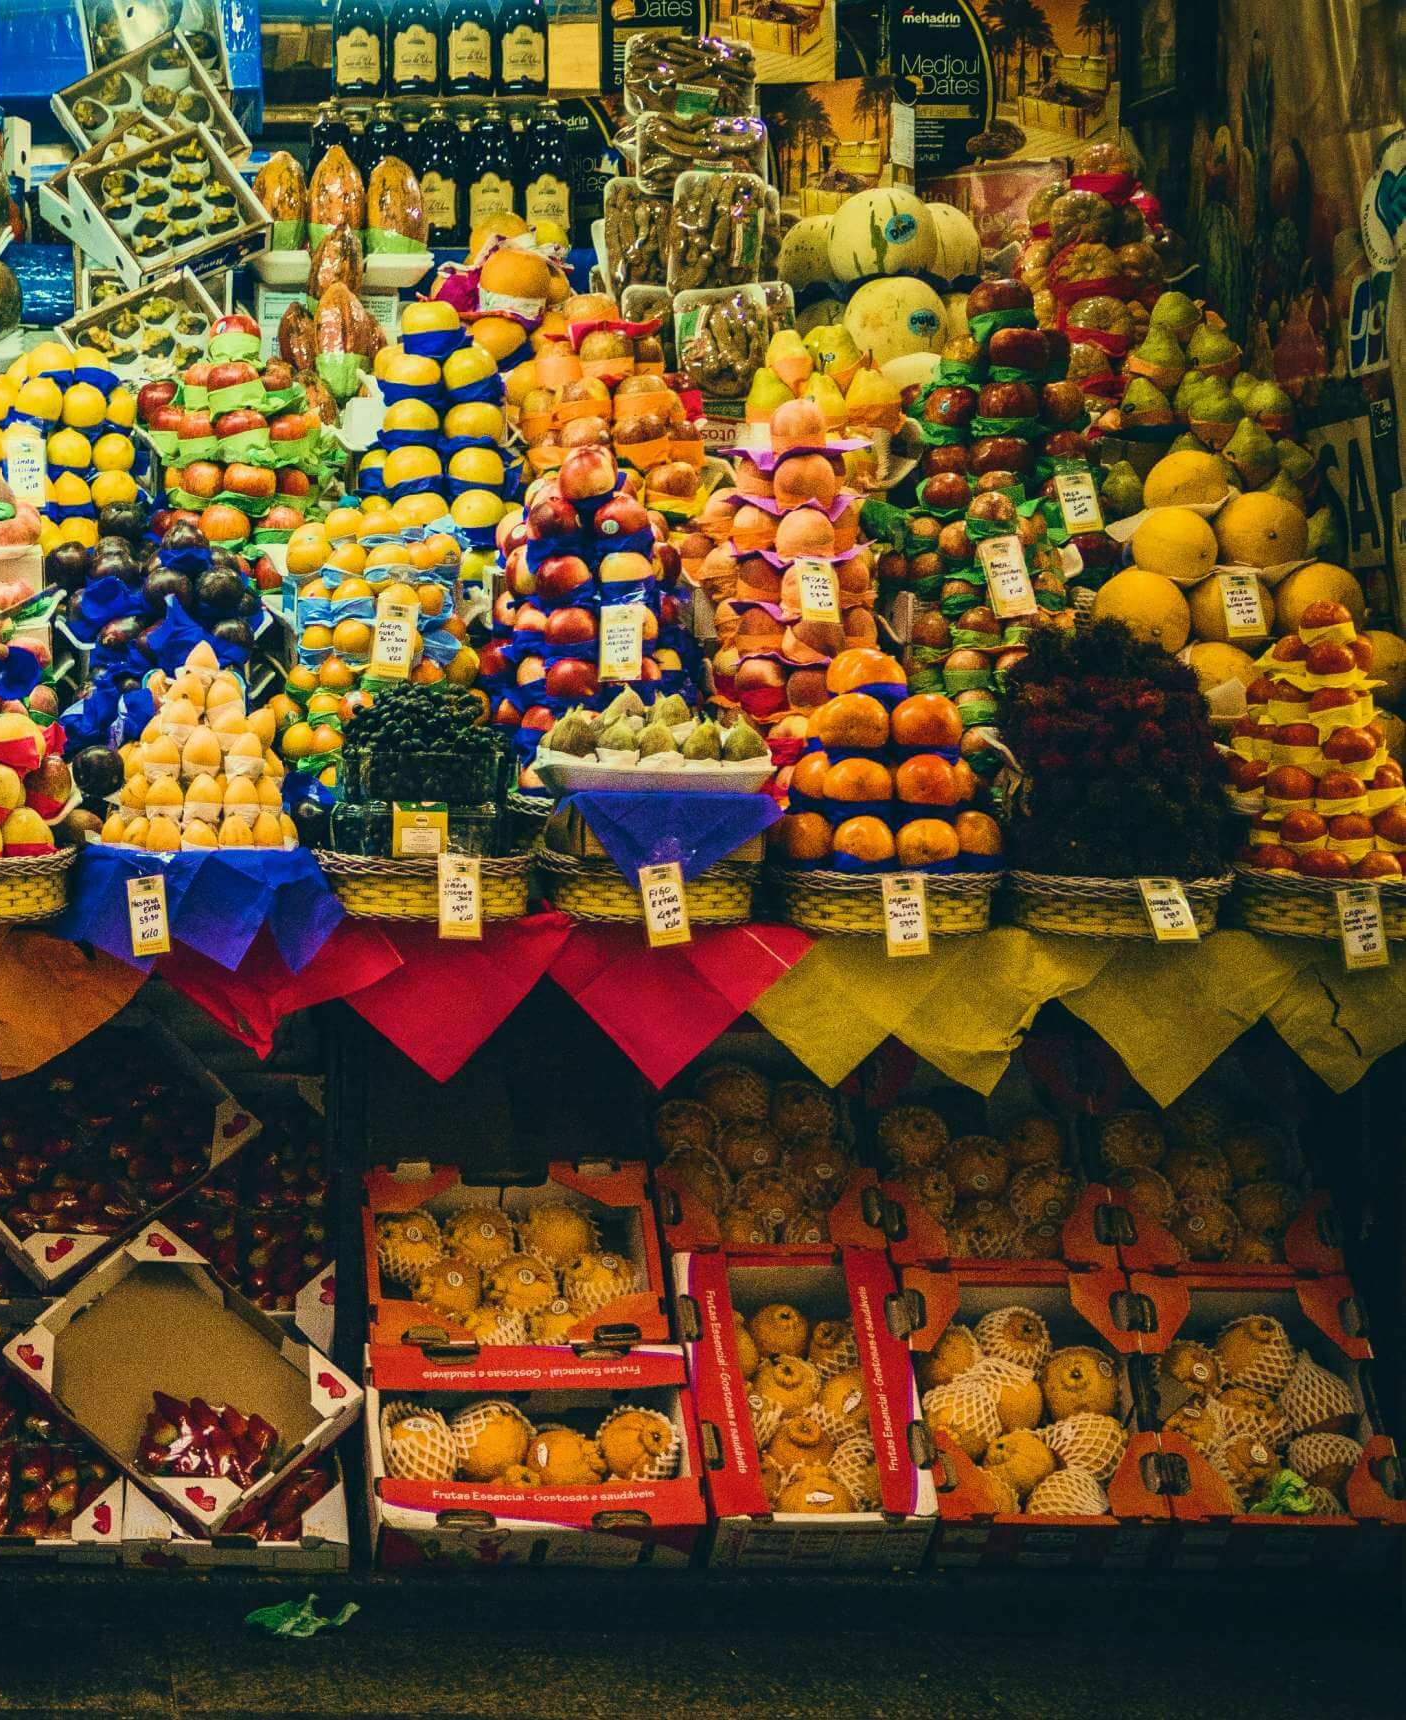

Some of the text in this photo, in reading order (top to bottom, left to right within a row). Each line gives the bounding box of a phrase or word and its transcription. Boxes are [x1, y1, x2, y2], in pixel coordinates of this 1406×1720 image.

[902, 12, 961, 24] mehadrin
[901, 54, 980, 79] Medjoul
[921, 74, 980, 95] Dates
[890, 221, 917, 241] Dino
[705, 1290, 717, 1323] Frutas
[711, 1323, 728, 1366] Essencial
[720, 1373, 735, 1420] Gostosas
[868, 1339, 885, 1386] Gostosas
[487, 1369, 542, 1379] Gostosas
[550, 1366, 601, 1377] Essencial
[603, 1365, 641, 1375] Frutas
[876, 1394, 894, 1438] Essencial
[883, 1438, 899, 1471] Frutas
[432, 1490, 471, 1500] Frutas
[473, 1491, 525, 1501] Essencial
[534, 1492, 589, 1502] Gostosas
[599, 1490, 656, 1501] saudáveis
